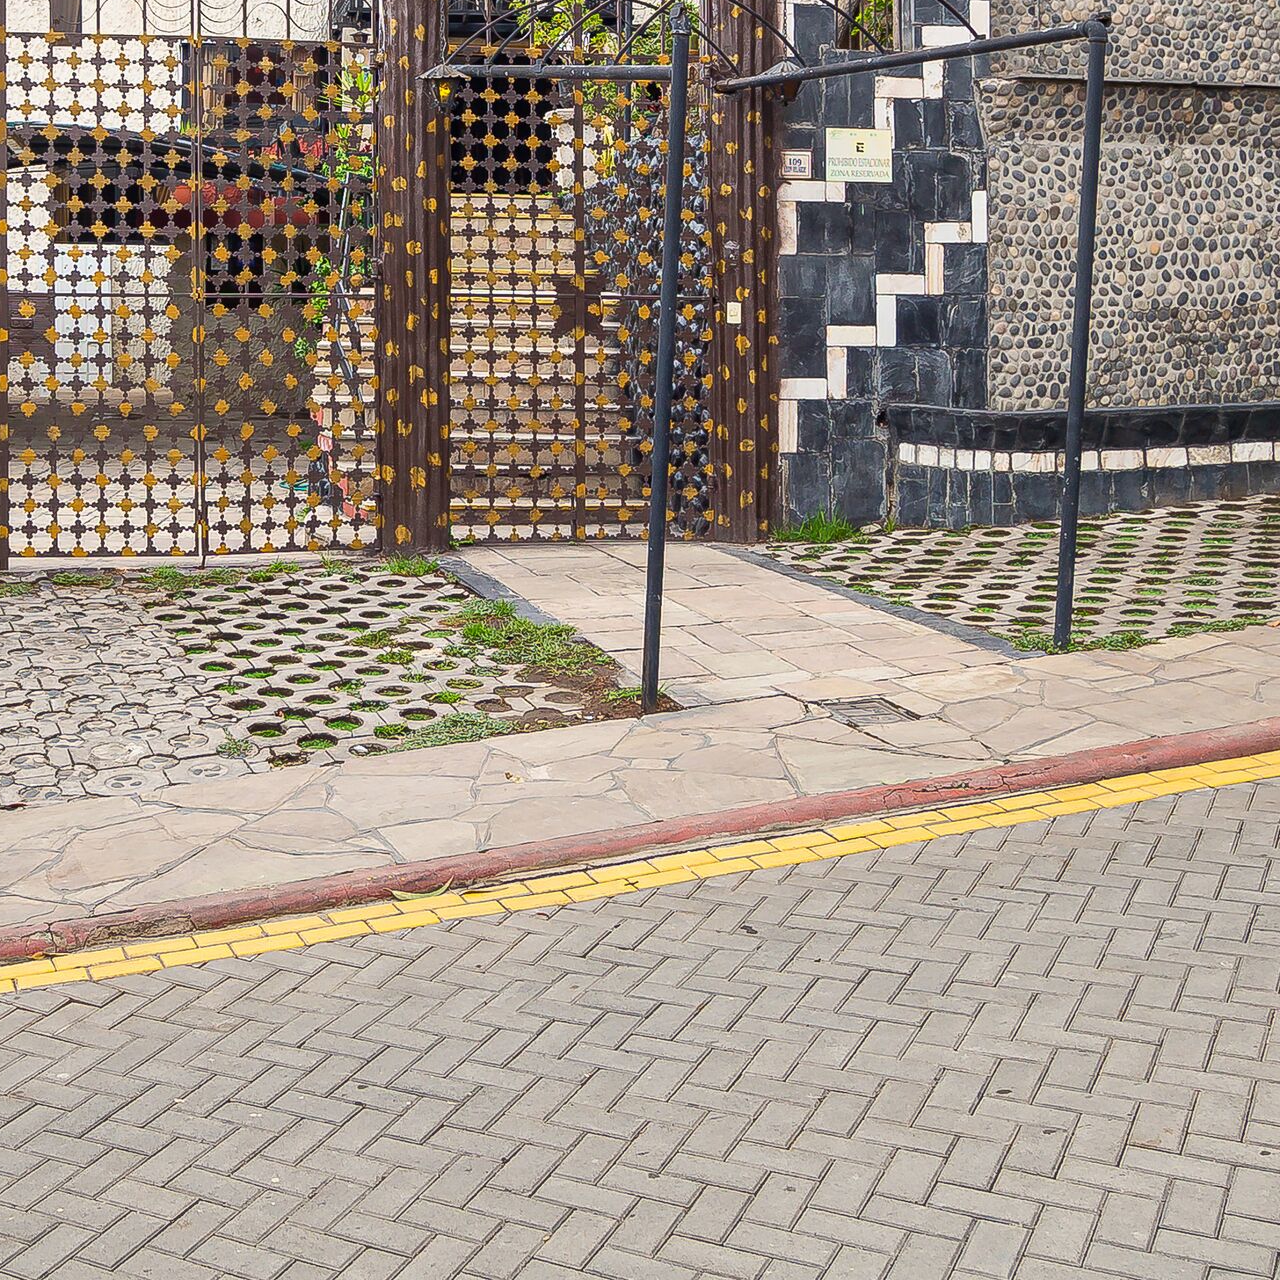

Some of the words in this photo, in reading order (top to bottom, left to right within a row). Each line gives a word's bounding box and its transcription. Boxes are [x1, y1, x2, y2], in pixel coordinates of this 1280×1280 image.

[788, 158, 802, 166] 109
[828, 157, 857, 167] PROHIBIDO
[858, 157, 890, 168] ESTACIONAR
[830, 169, 850, 177] ZONA
[851, 169, 890, 178] RESERVADA
